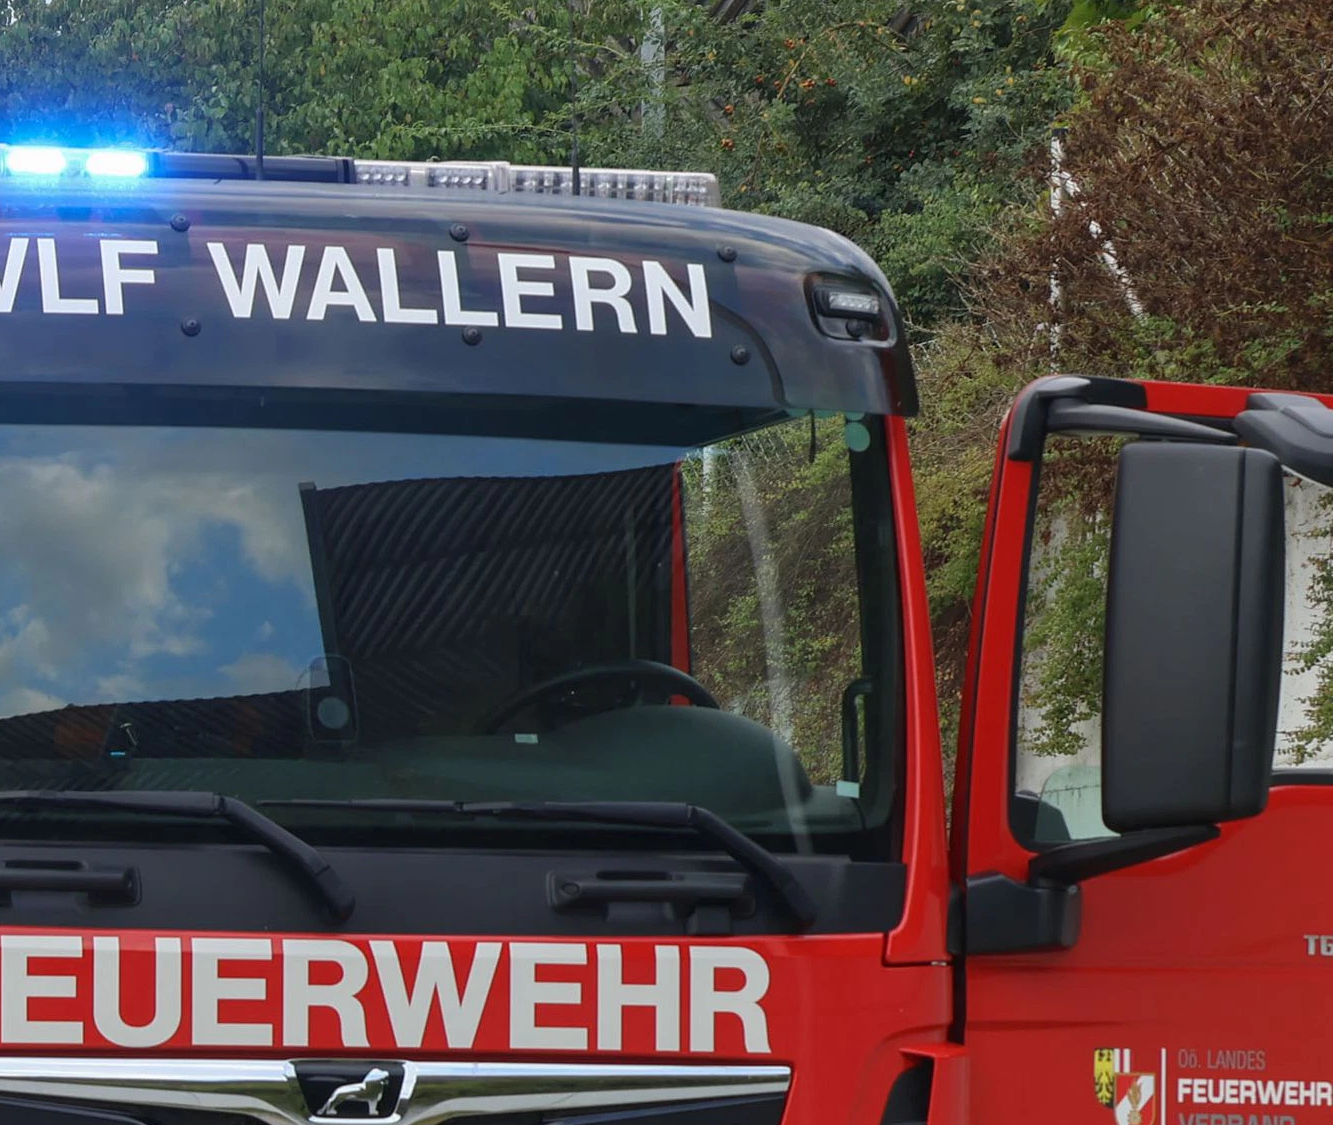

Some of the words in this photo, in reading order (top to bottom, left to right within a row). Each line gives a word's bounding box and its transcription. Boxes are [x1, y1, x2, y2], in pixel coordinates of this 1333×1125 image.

[205, 241, 713, 339] WALLERN
[1207, 1049, 1266, 1071] LANDES
[1177, 1078, 1333, 1106] FEUERWEHR
